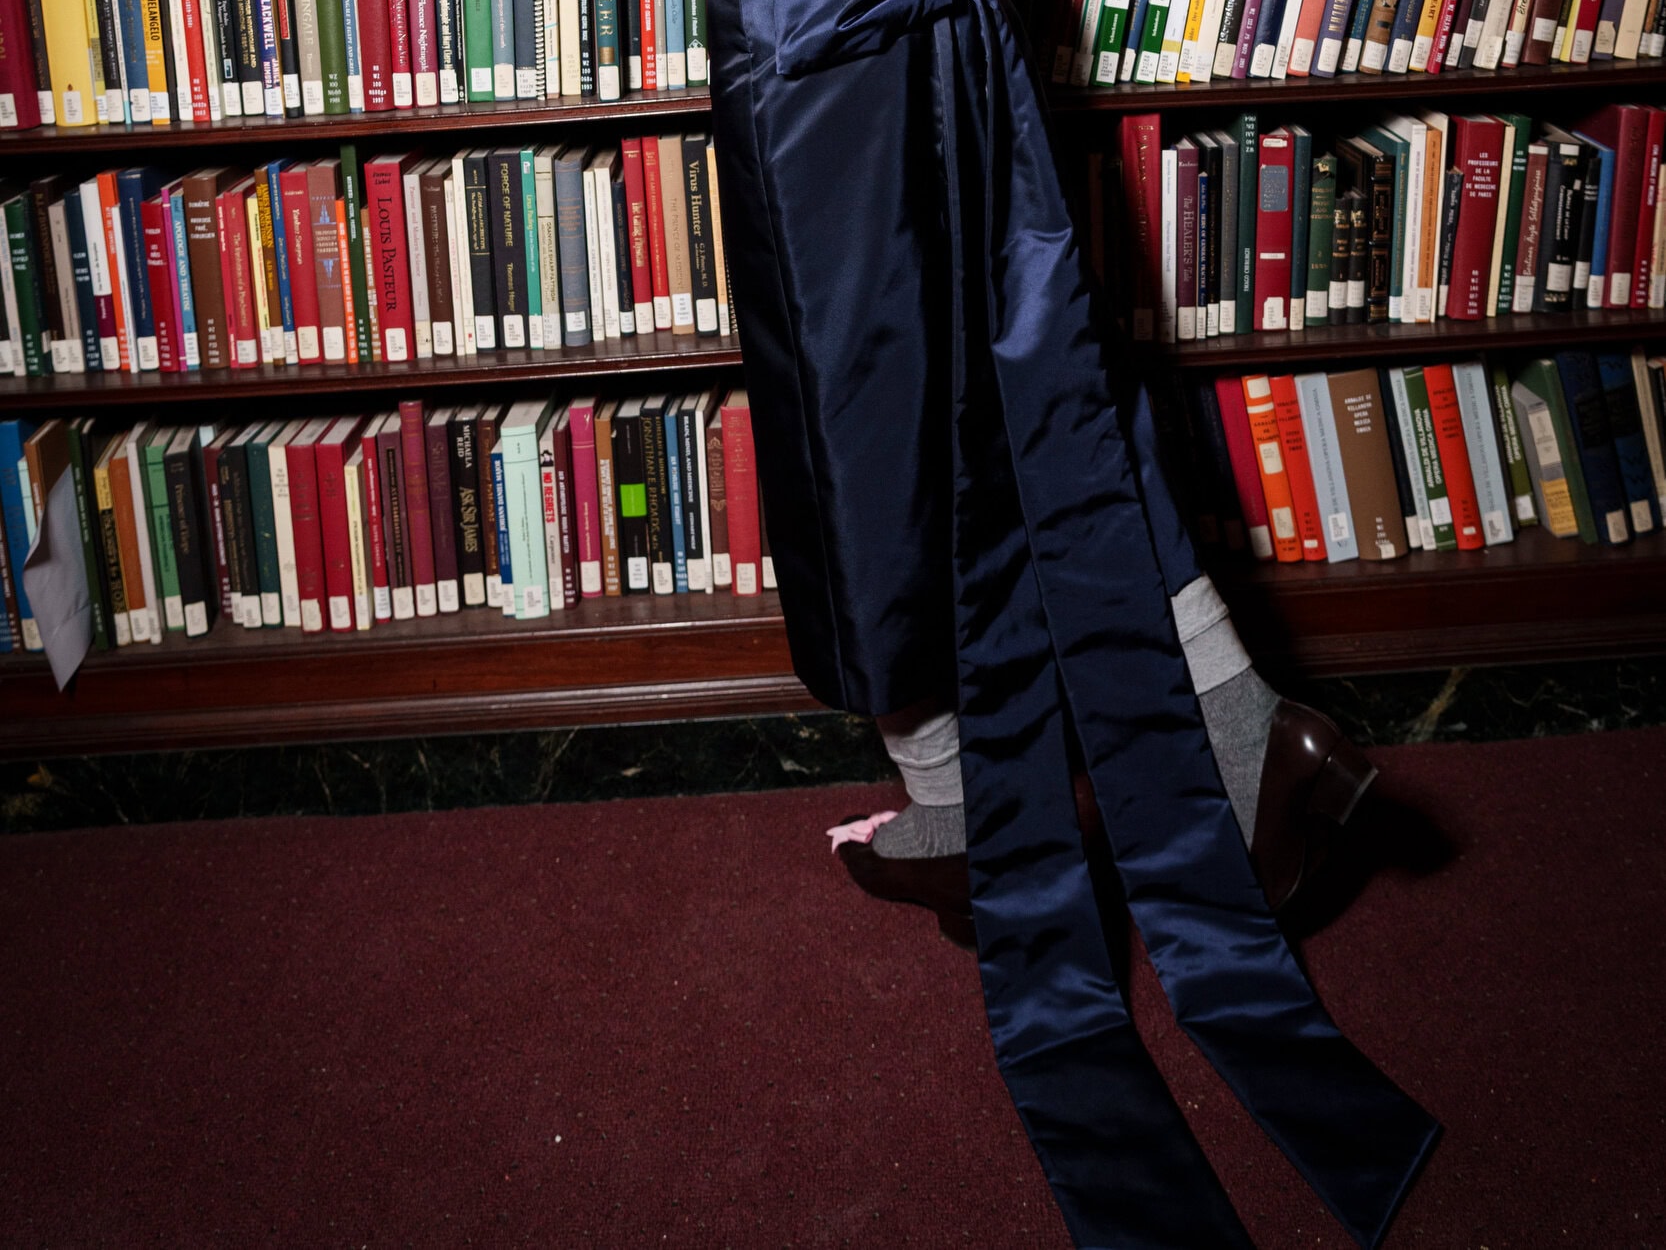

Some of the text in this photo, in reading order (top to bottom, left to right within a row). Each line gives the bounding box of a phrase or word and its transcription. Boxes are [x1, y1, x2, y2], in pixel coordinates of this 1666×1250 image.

[500, 163, 513, 247] FORCE OF NATURE
[688, 160, 703, 237] Virus Hunter
[377, 197, 397, 312] LOUIS PASTEUR
[1183, 195, 1195, 282] The HEALER'S Tale
[463, 424, 472, 468] MICHAELA
[459, 487, 479, 553] ASK SIR JAMES
[543, 472, 555, 523] NO REGRETS
